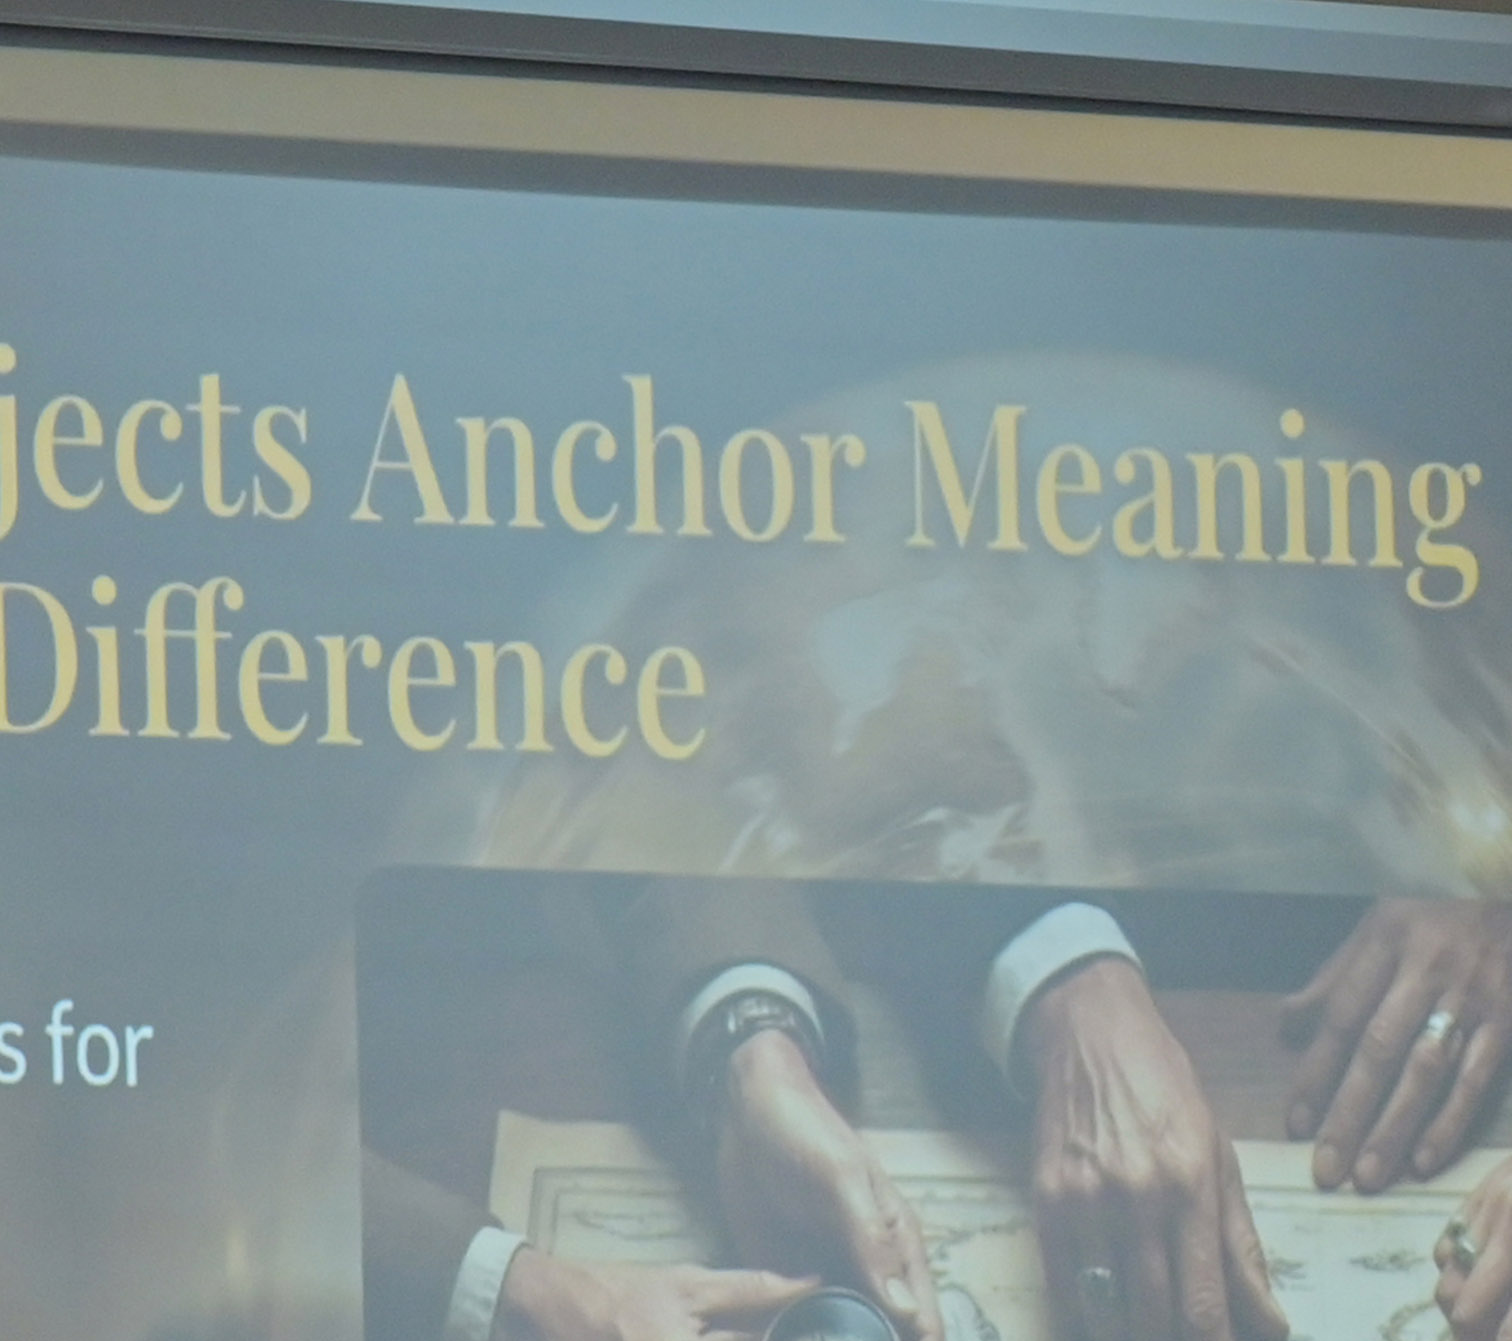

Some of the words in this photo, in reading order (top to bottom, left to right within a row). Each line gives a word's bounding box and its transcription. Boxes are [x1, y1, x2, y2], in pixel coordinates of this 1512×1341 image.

[349, 372, 866, 546] Anchor
[905, 400, 1480, 608] Meaning
[44, 1000, 154, 1088] for
